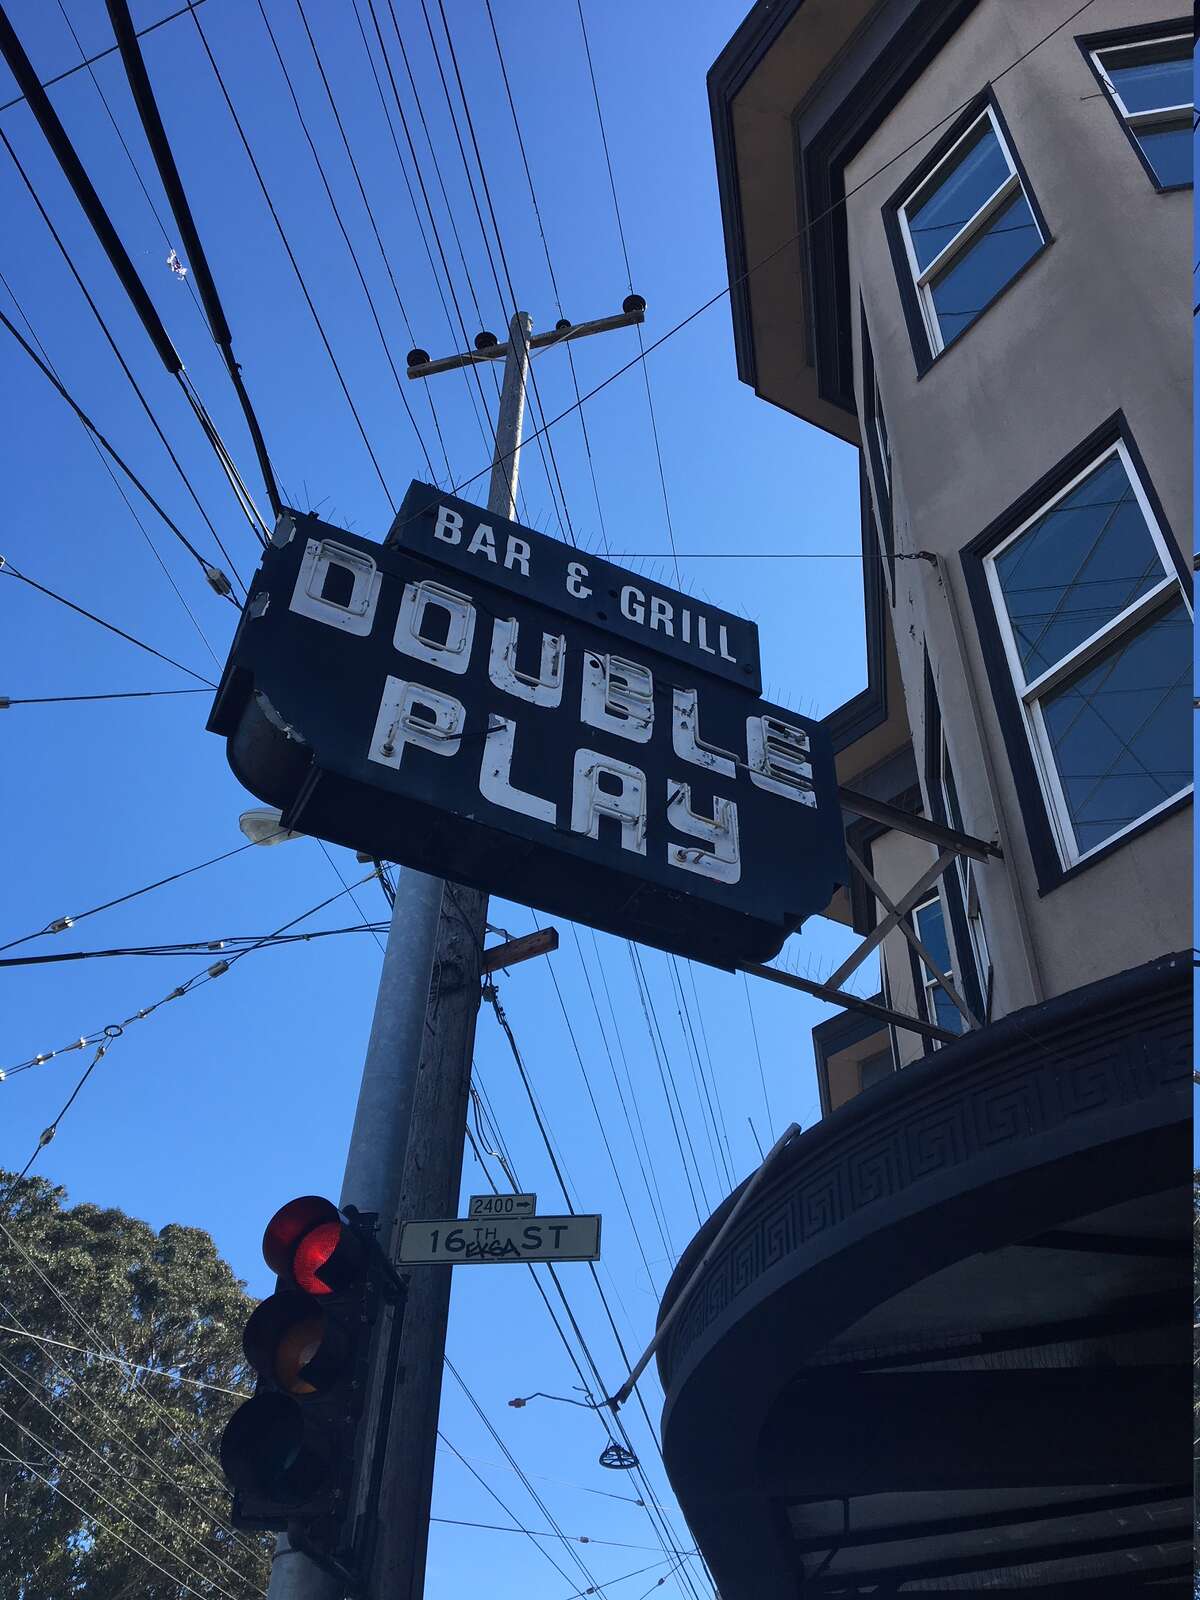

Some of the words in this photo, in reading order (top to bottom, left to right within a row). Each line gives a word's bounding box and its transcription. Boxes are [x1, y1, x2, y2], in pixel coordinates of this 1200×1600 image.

[433, 504, 532, 579] BAR
[566, 561, 594, 600] &
[620, 585, 738, 664] GRILL
[289, 537, 818, 810] DOUBLE
[367, 675, 741, 885] PLAY
[473, 1198, 515, 1214] 2400
[521, 1225, 569, 1250] ST
